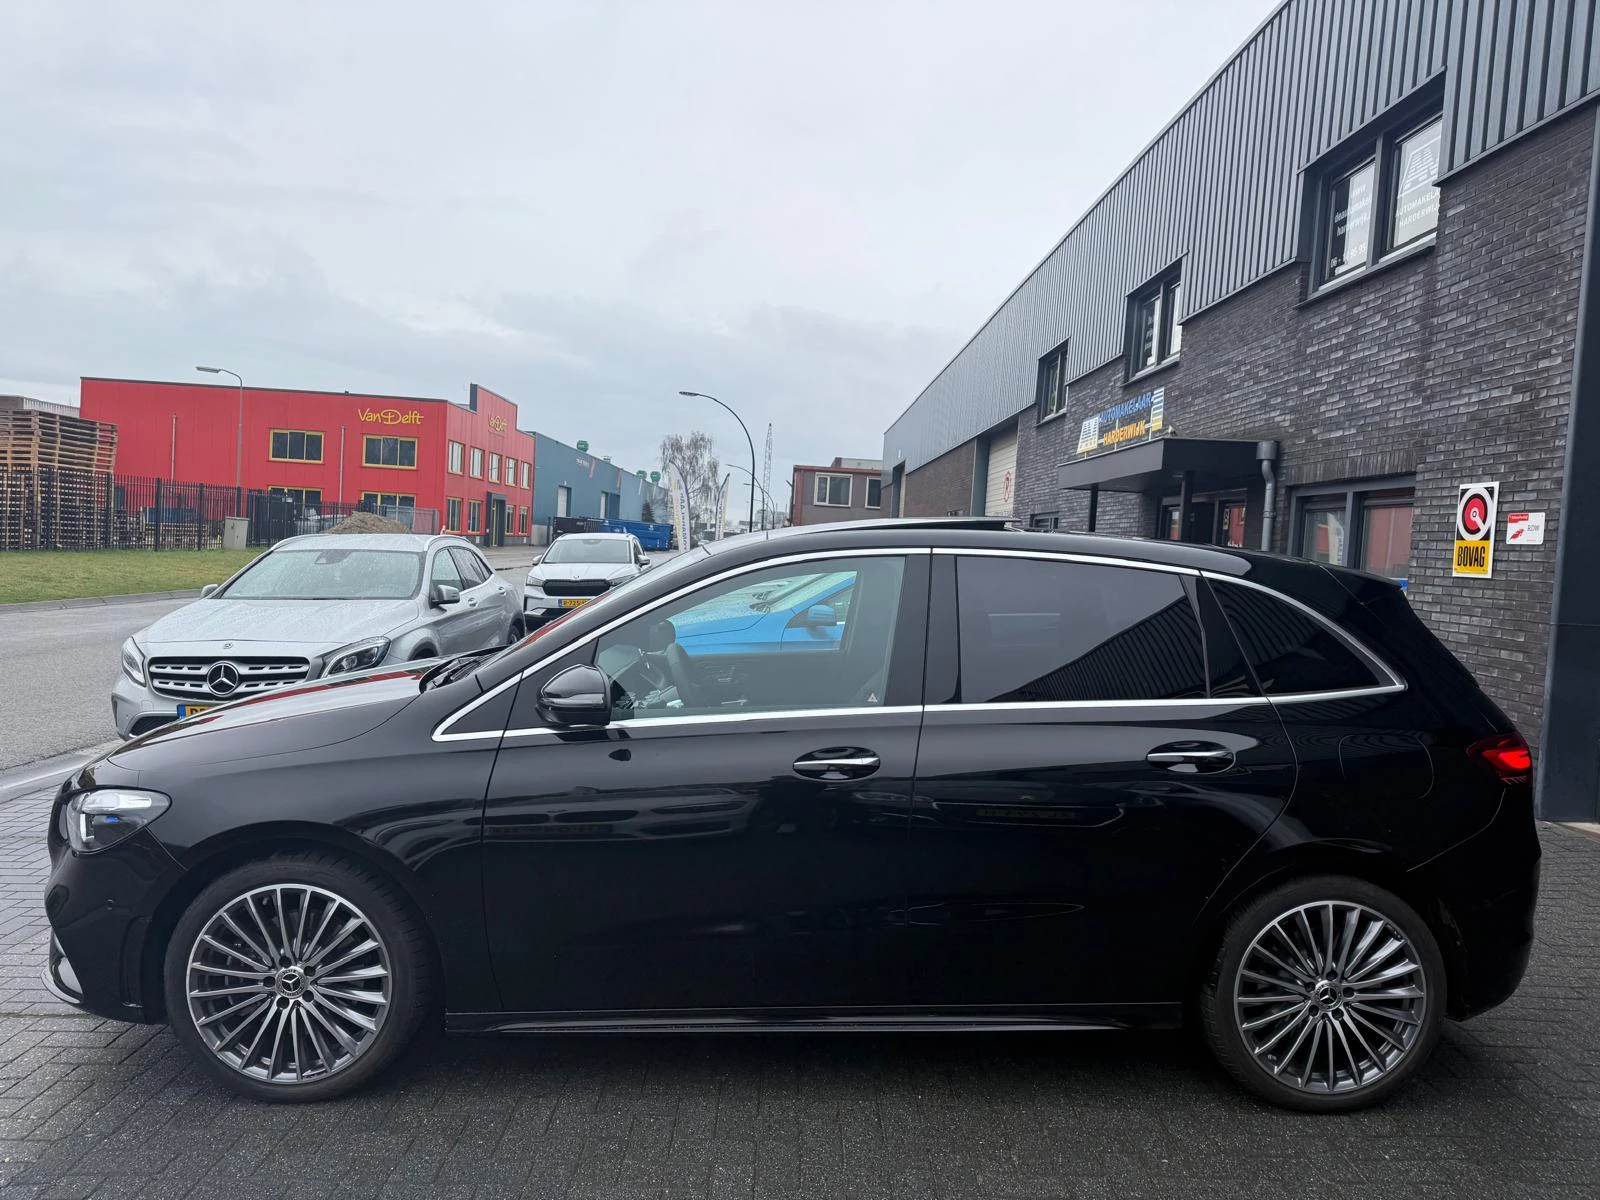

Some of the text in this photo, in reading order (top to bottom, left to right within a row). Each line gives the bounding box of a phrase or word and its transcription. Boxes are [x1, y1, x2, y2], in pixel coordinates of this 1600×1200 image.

[1100, 391, 1152, 423] AUTOMAKELAAR
[1103, 420, 1146, 446] HARDERWIJK
[1457, 545, 1486, 567] BOVAG
